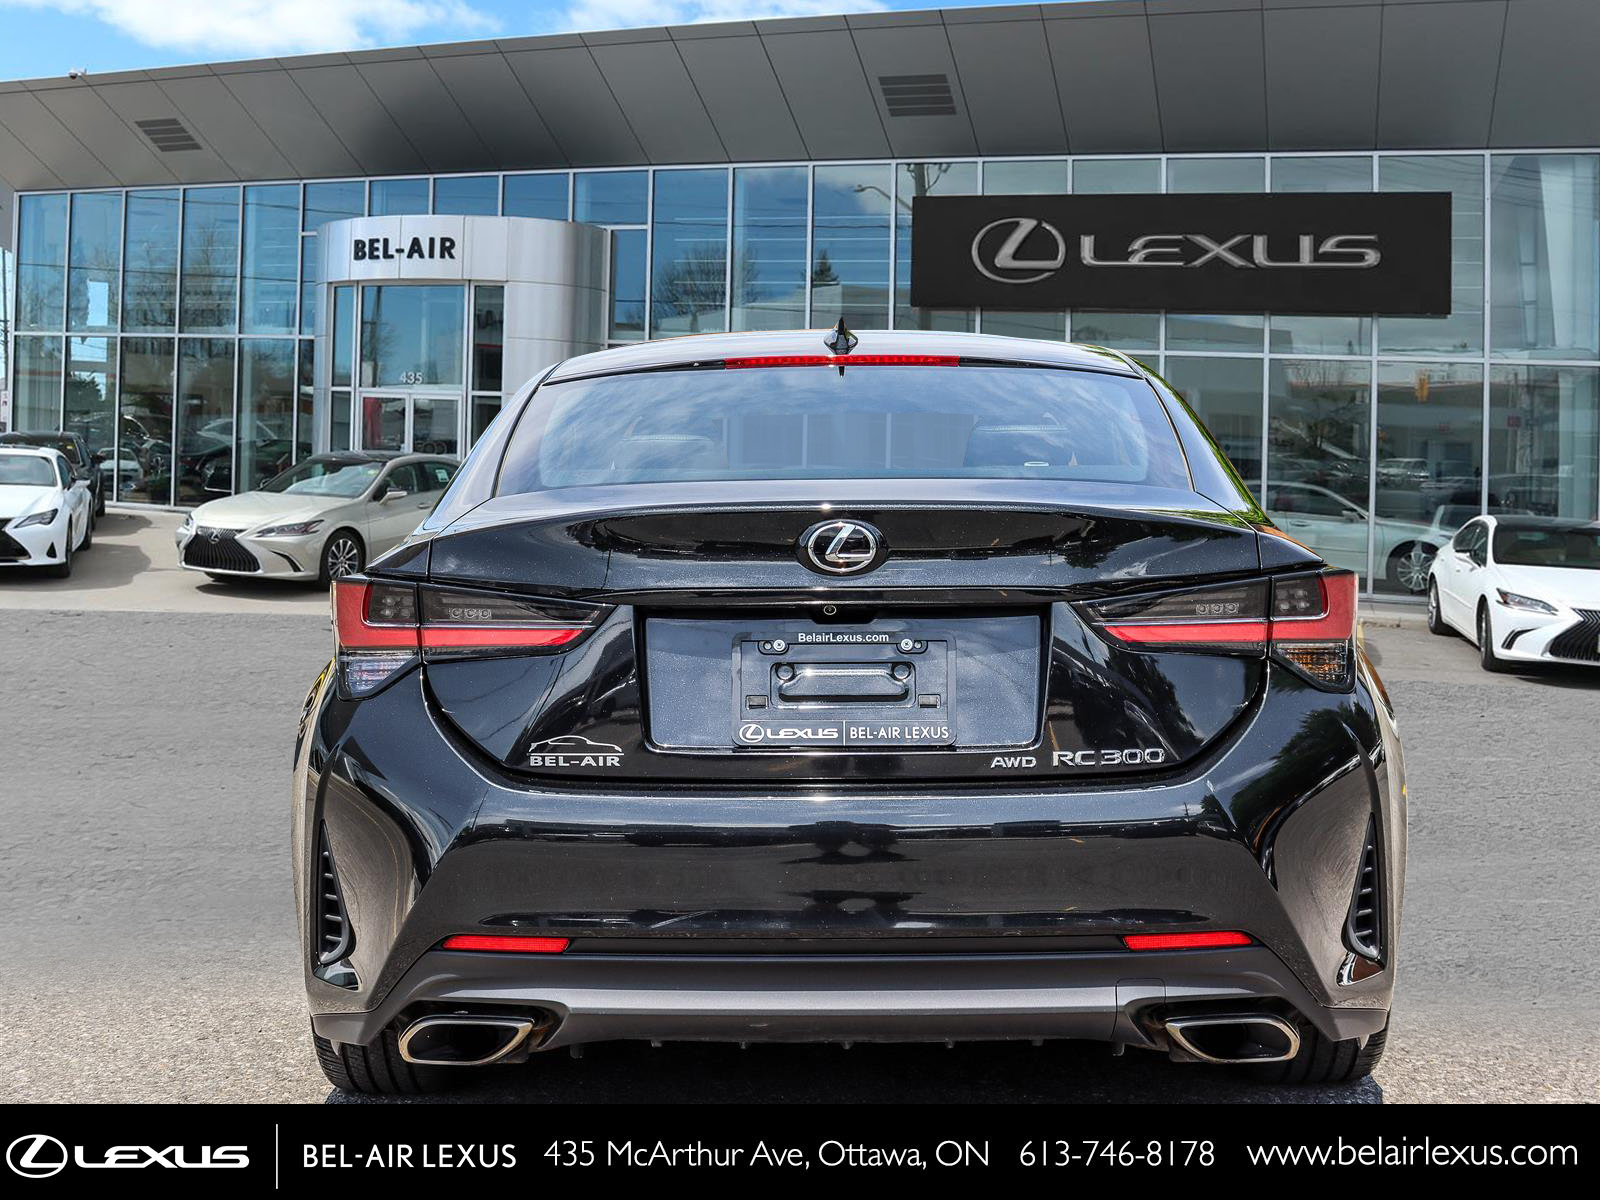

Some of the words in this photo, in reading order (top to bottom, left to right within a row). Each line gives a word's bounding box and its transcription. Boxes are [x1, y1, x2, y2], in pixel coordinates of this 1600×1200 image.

[353, 237, 456, 261] BEL-AIR
[1079, 234, 1382, 270] LEXUS
[400, 371, 423, 384] 435
[798, 632, 889, 644] BelairLexus.com
[766, 728, 839, 739] LEXUS
[849, 726, 900, 740] BEL-AIR
[905, 726, 949, 740] LEXUS
[530, 756, 621, 767] BEL-AIR
[990, 756, 1037, 769] AWD
